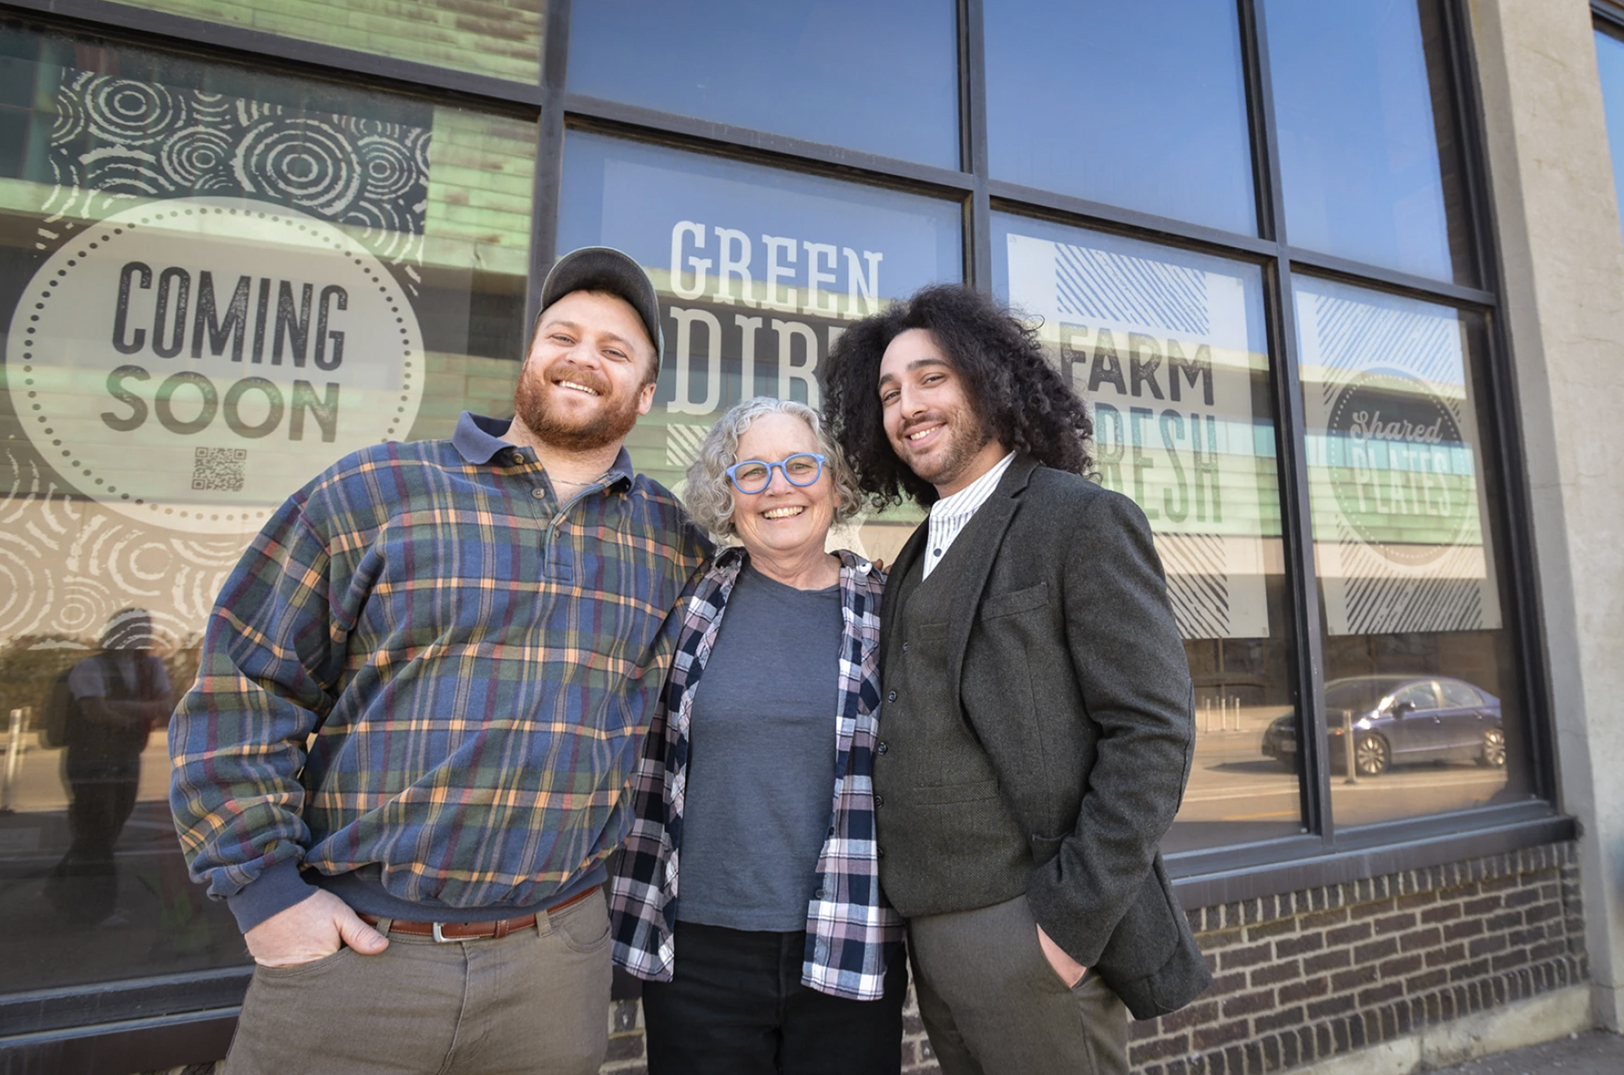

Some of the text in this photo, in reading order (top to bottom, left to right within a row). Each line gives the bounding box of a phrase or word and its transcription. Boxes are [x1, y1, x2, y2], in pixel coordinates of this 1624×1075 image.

[112, 261, 348, 371] COMING
[670, 220, 883, 321] GREEN
[100, 364, 340, 442] SOON
[667, 306, 846, 415] DIR
[1059, 321, 1214, 406] FARM
[1094, 402, 1222, 523] RESH
[1350, 410, 1443, 444] Shared
[1352, 446, 1451, 517] PLATES
